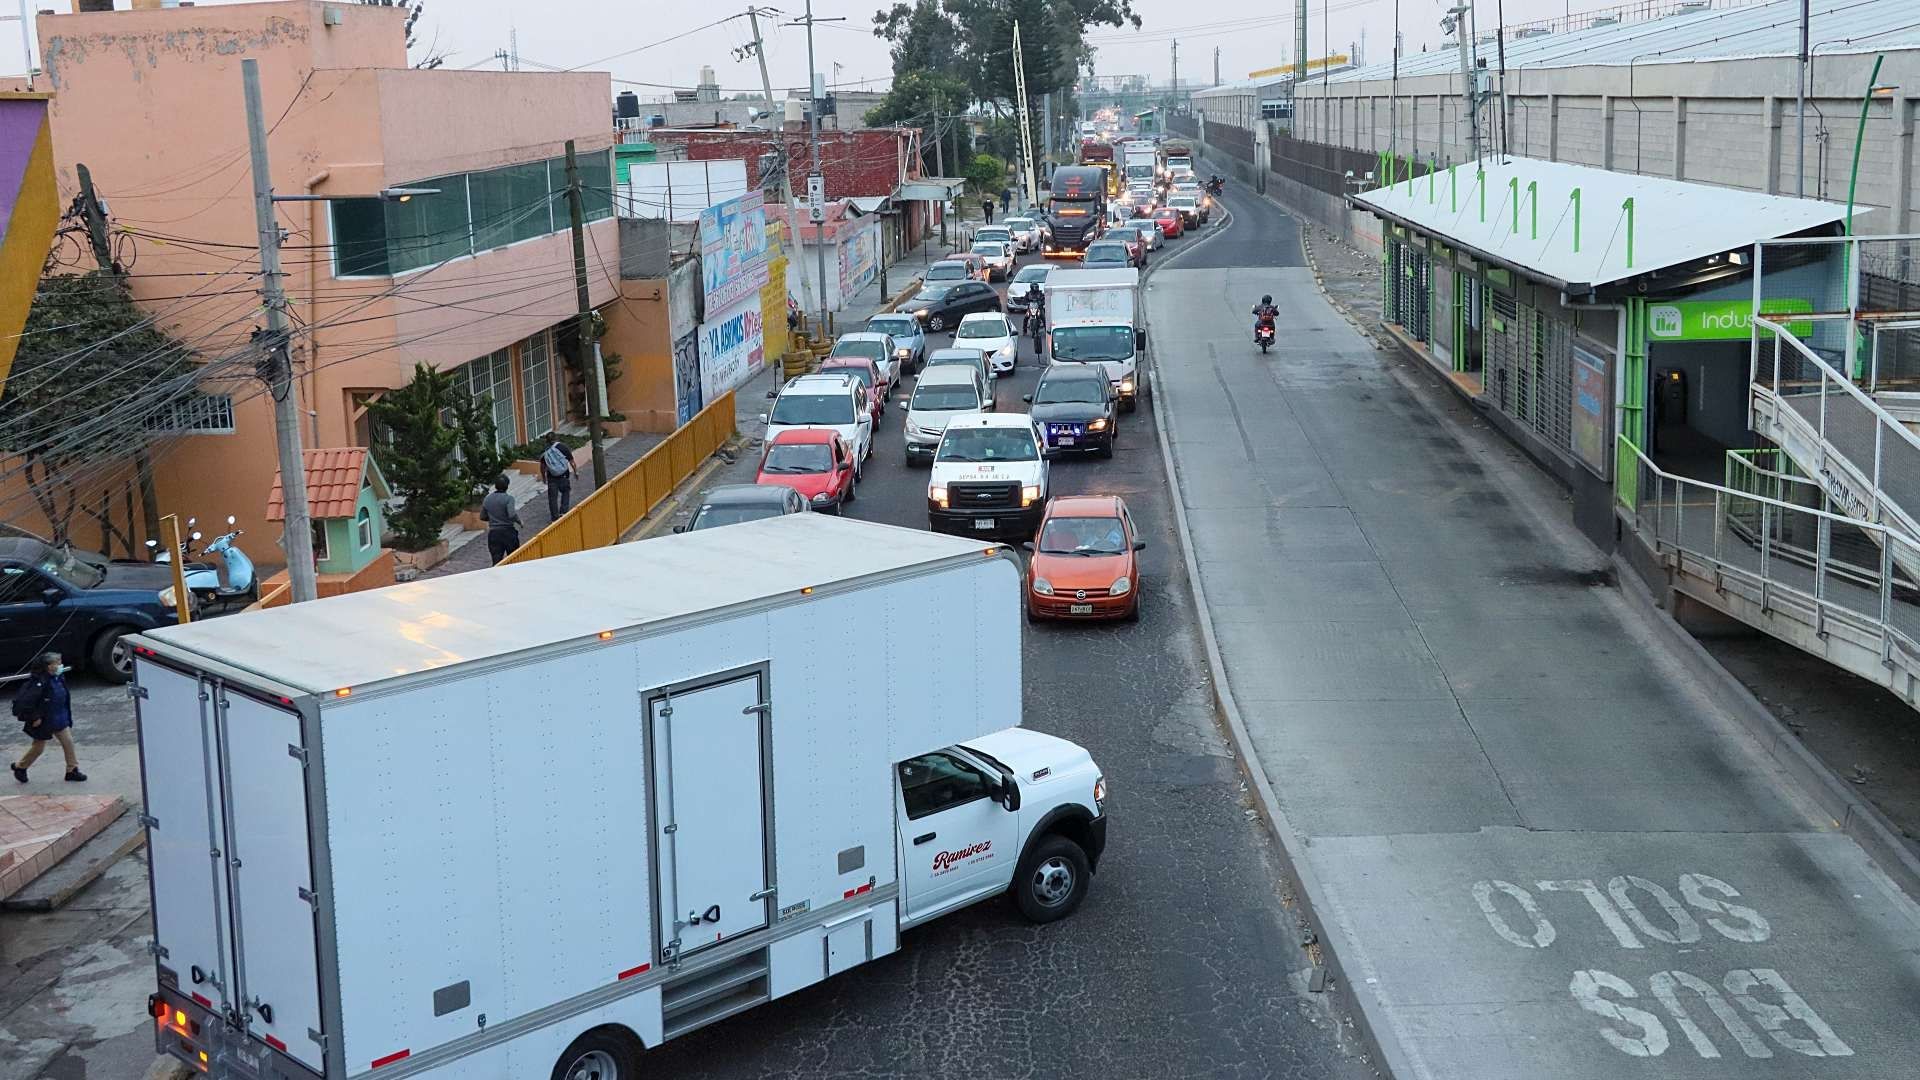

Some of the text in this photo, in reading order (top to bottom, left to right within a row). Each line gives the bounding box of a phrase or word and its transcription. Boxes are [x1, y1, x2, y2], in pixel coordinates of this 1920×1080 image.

[1702, 309, 1792, 328] Indus
[709, 328, 720, 358] YA
[932, 840, 992, 870] Ramirez
[1472, 873, 1771, 948] SOLO
[1569, 969, 1856, 1058] BUS
